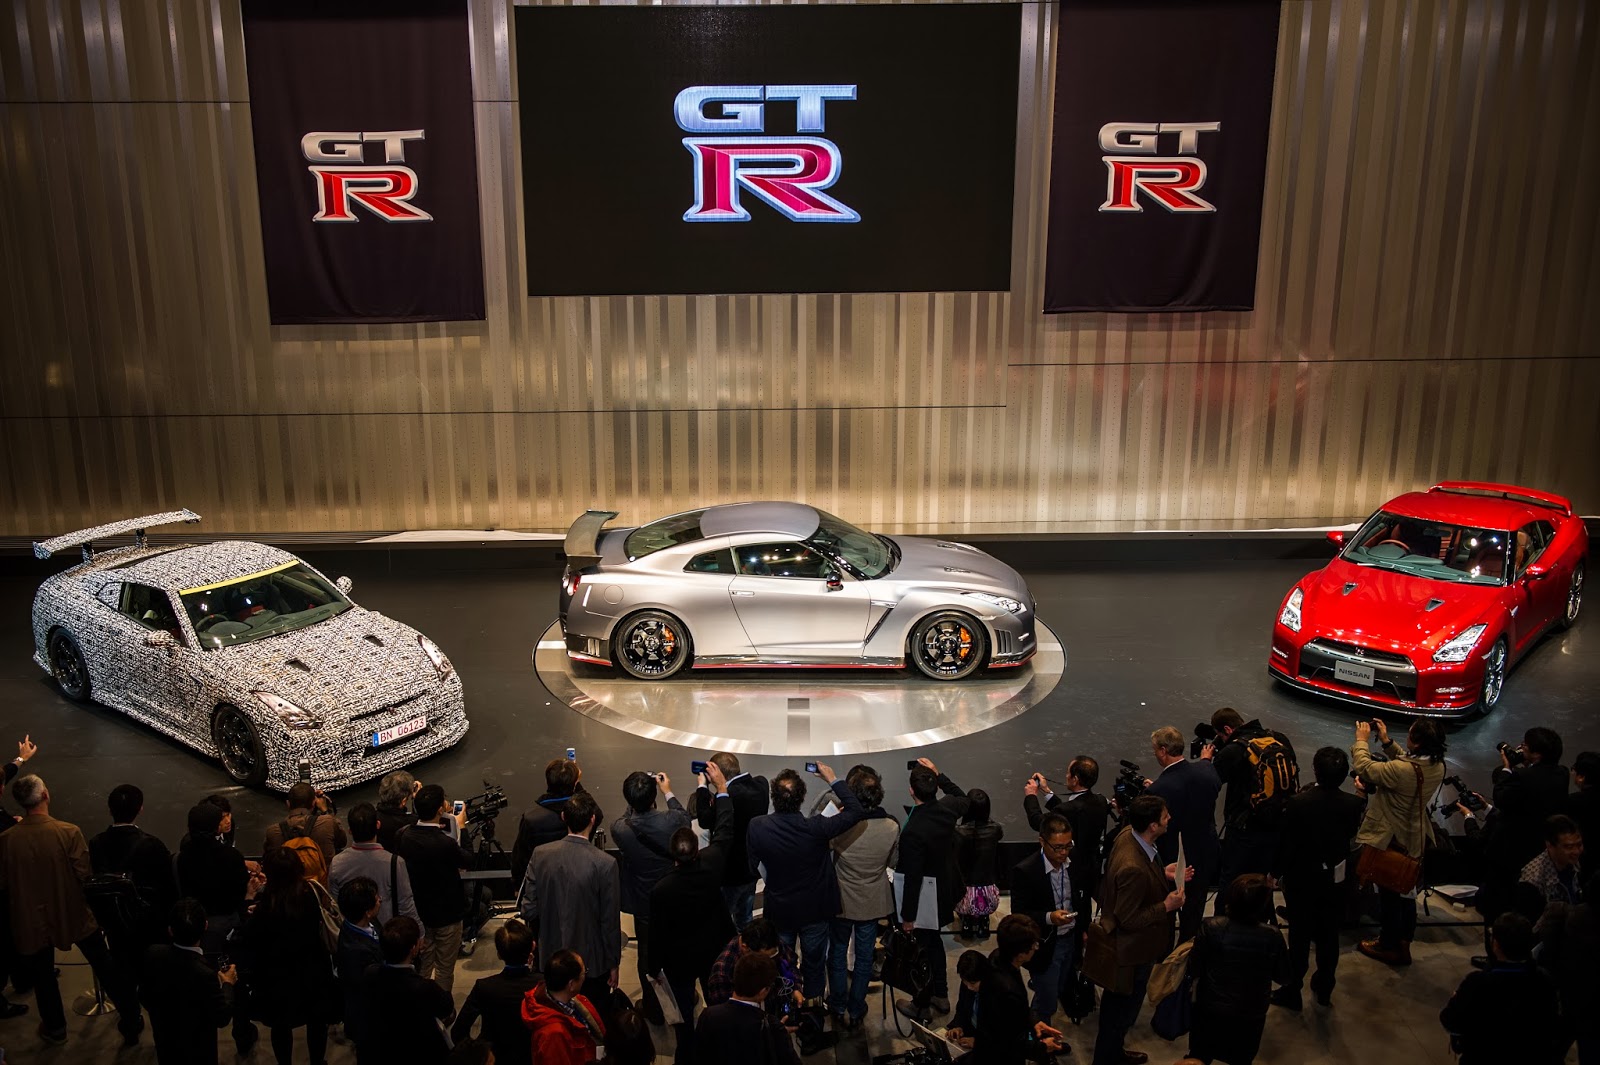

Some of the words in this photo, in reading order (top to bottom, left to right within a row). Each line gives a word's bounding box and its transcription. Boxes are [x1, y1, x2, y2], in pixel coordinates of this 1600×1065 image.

[673, 84, 857, 133] GT
[301, 129, 425, 163] GT
[1098, 121, 1221, 154] GT
[308, 165, 433, 223] R
[682, 136, 861, 222] R
[1098, 156, 1217, 213] R
[1338, 668, 1371, 680] NISSAN
[380, 729, 393, 742] BN
[397, 717, 425, 736] 06123
